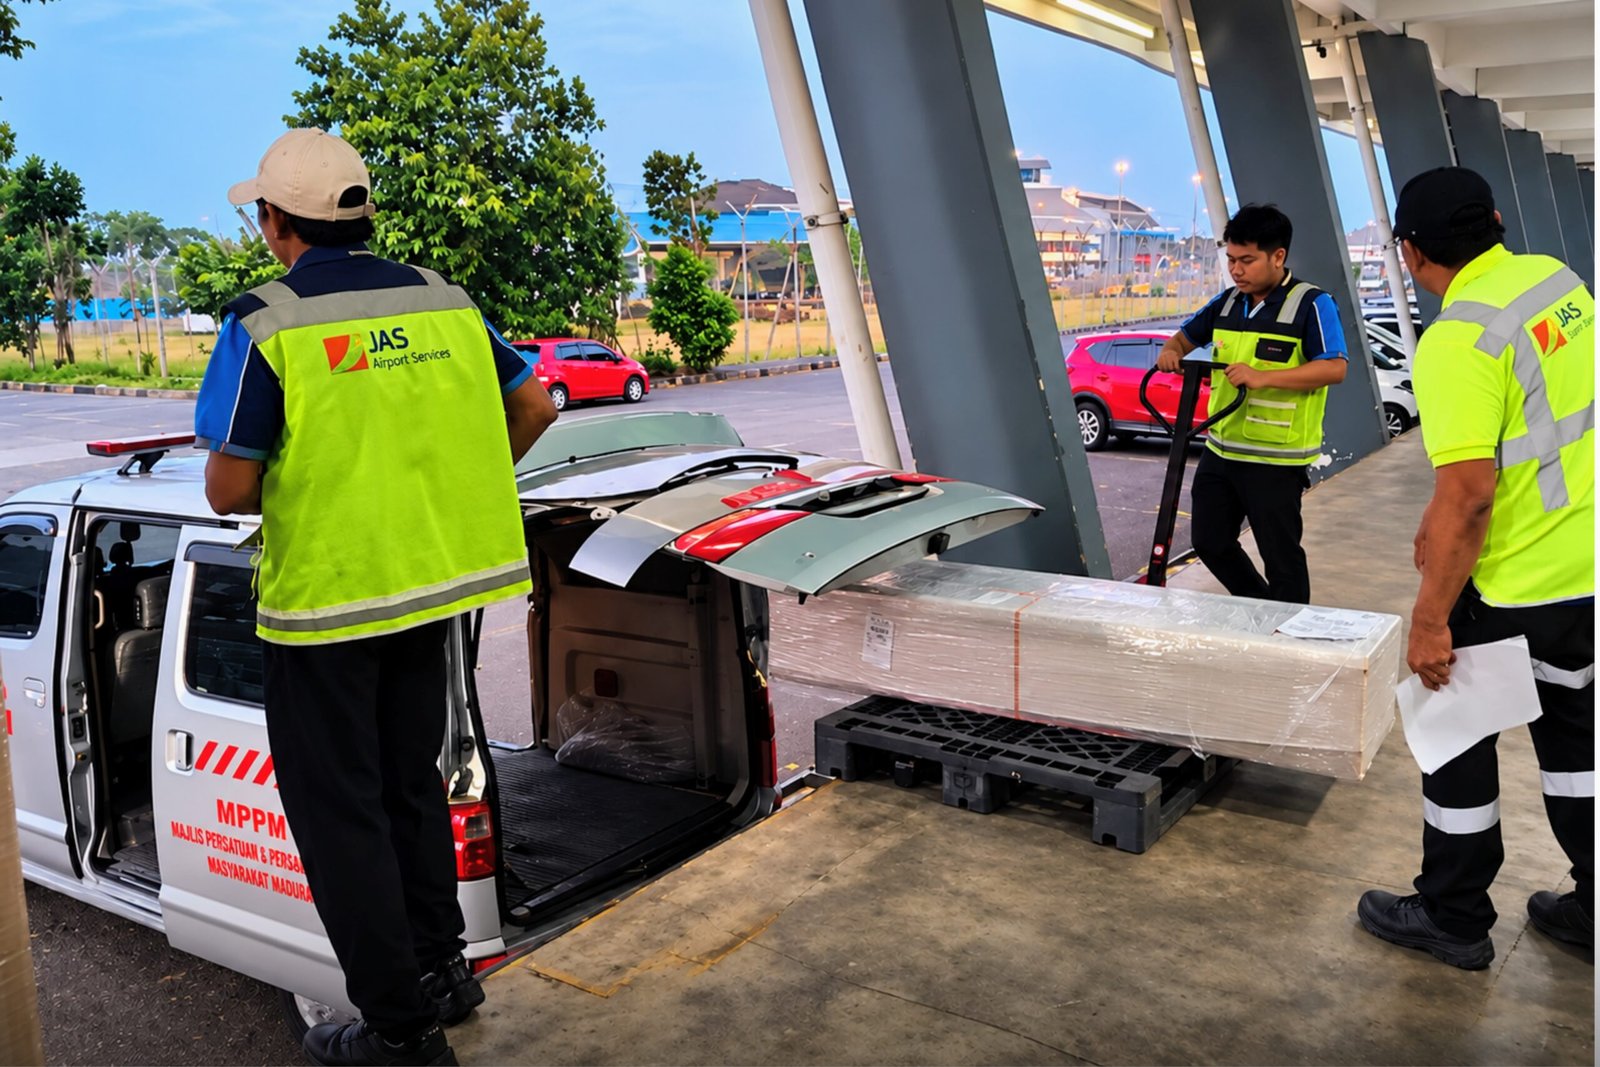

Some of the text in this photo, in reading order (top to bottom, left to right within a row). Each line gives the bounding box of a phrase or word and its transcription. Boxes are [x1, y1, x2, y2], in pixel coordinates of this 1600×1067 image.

[1554, 301, 1582, 328] JAS
[369, 327, 409, 354] JAS
[373, 349, 451, 370] Airport Services
[216, 798, 287, 841] MPPM
[171, 821, 204, 846] MAJLIS
[205, 830, 259, 862] PERSATUAN
[260, 846, 267, 865] &
[207, 856, 269, 890] MASYARAKAT
